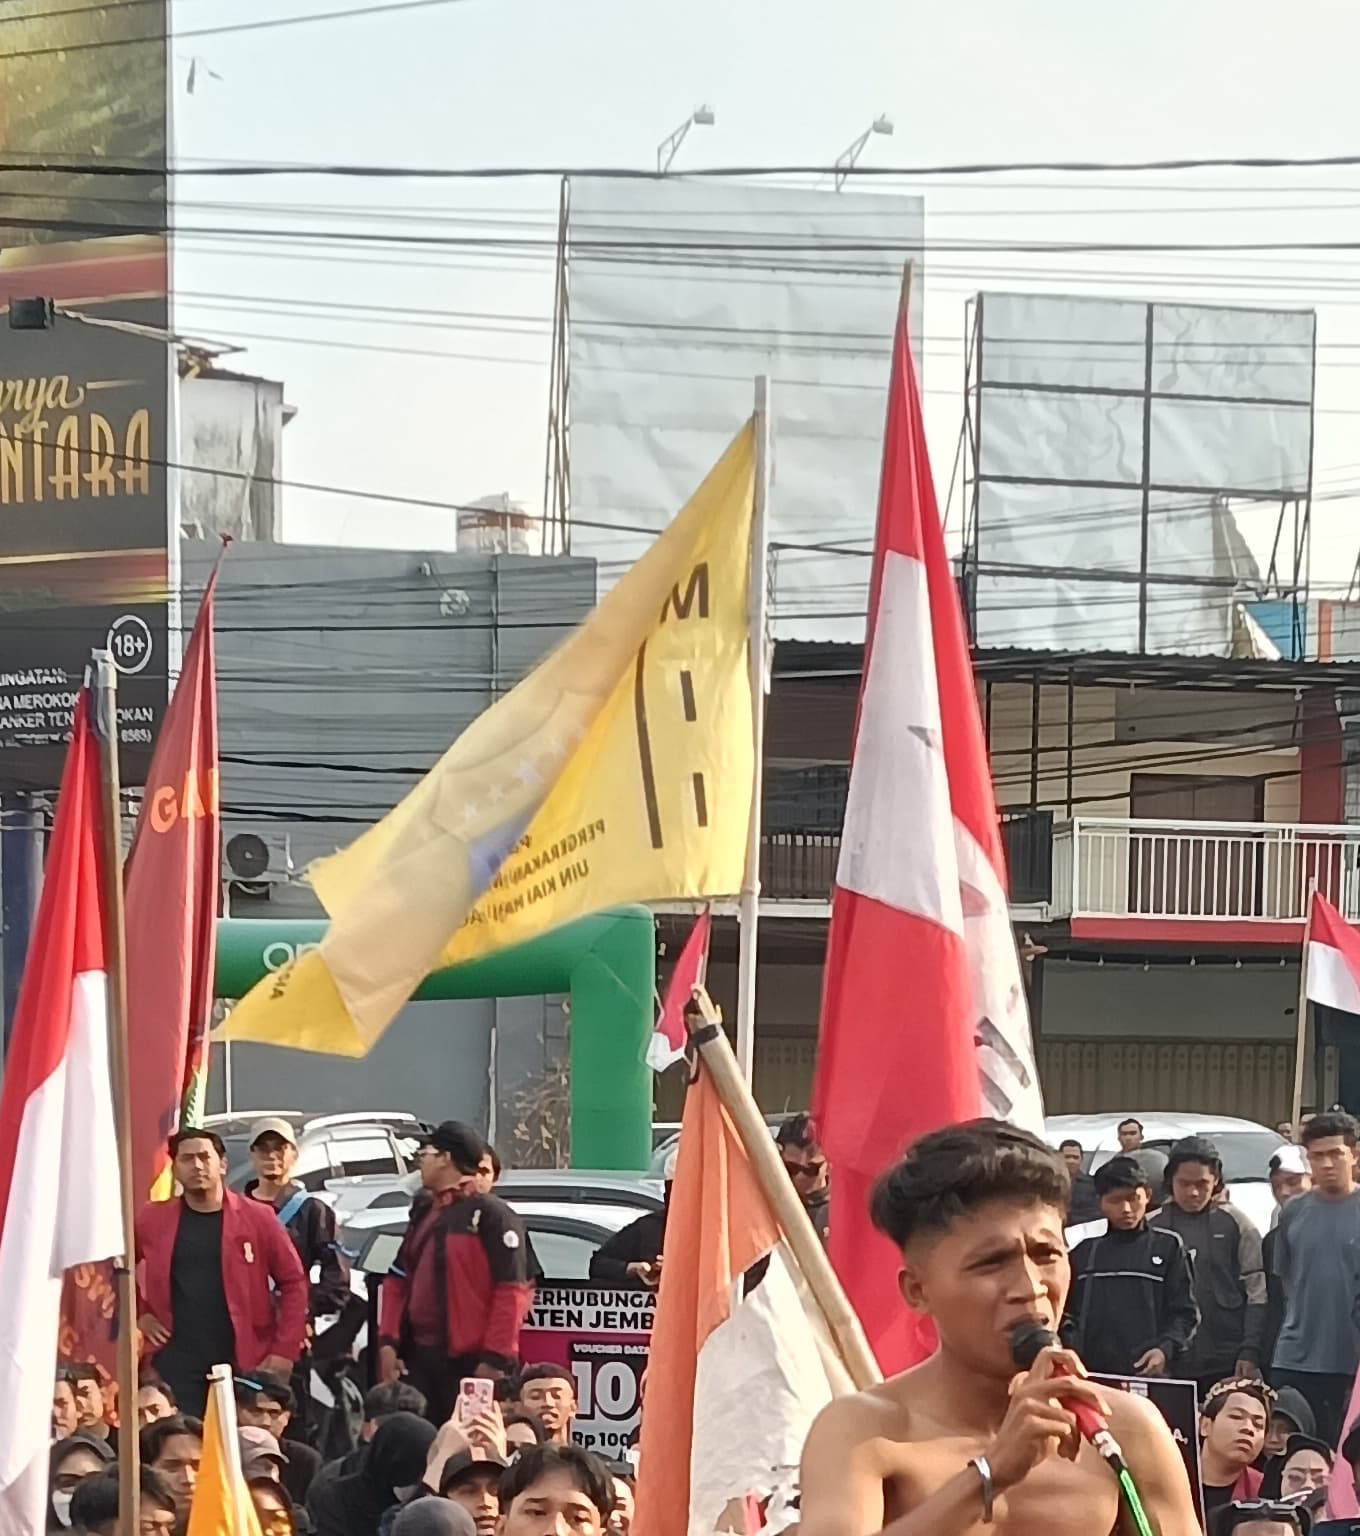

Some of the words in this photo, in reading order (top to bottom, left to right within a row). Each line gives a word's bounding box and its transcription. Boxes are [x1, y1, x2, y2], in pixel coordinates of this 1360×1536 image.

[114, 634, 145, 657] 18+
[533, 1290, 657, 1308] ERHUBUNGA
[589, 1311, 656, 1330] JEMB
